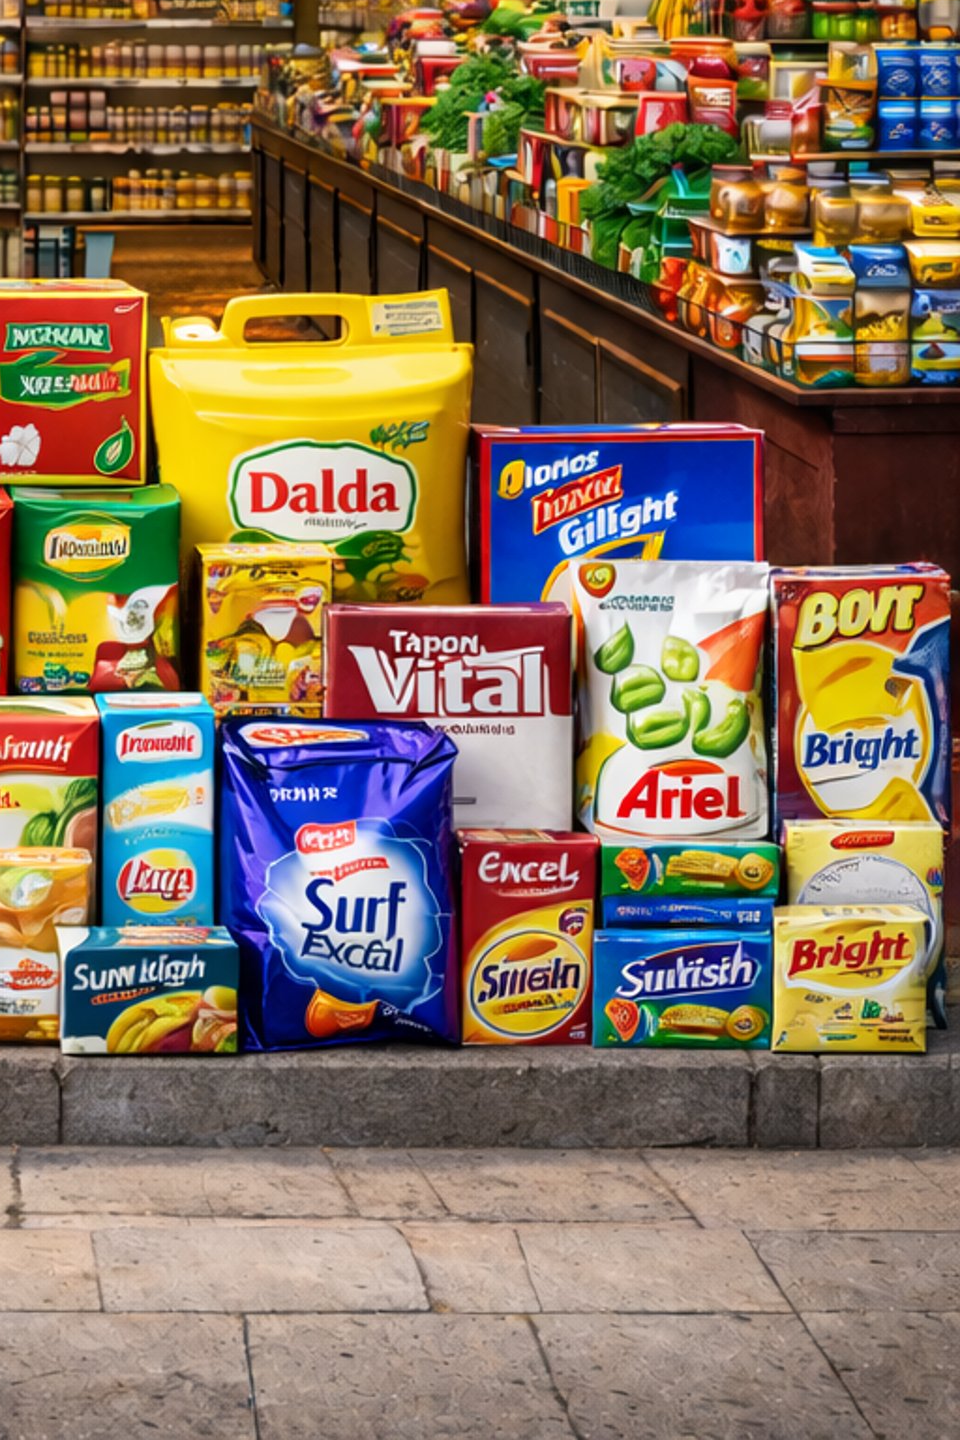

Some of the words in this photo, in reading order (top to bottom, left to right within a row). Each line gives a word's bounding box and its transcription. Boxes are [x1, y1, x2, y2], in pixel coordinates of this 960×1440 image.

[248, 467, 400, 514] Dalda
[347, 645, 547, 715] Vital
[616, 768, 747, 820] Ariel
[301, 877, 407, 942] Surf
[787, 930, 913, 981] Bright
